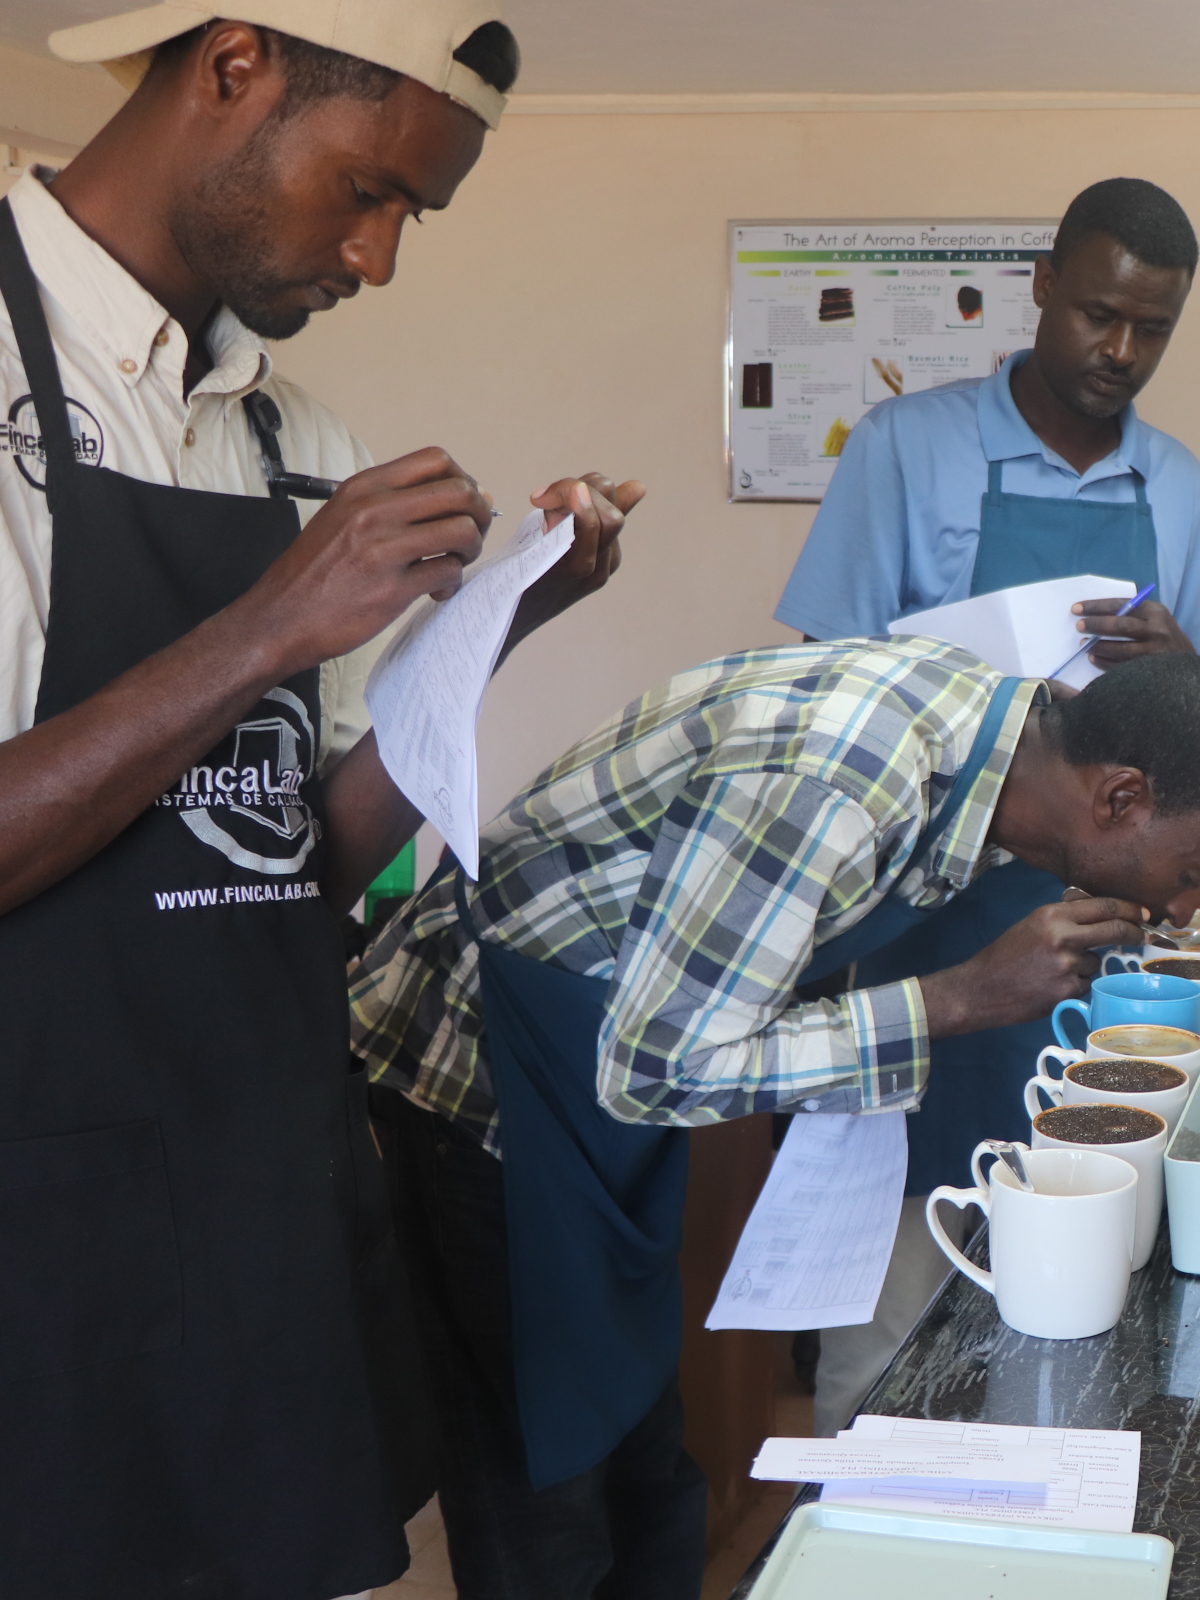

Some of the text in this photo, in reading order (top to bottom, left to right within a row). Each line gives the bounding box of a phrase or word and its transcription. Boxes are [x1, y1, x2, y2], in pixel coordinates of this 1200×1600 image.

[784, 233, 809, 247] The
[815, 233, 837, 246] Art
[843, 233, 858, 246] of
[863, 233, 915, 246] Aroma
[921, 233, 995, 249] Perception
[1001, 233, 1015, 246] in
[903, 269, 946, 277] FERMENTED
[242, 793, 262, 806] DE
